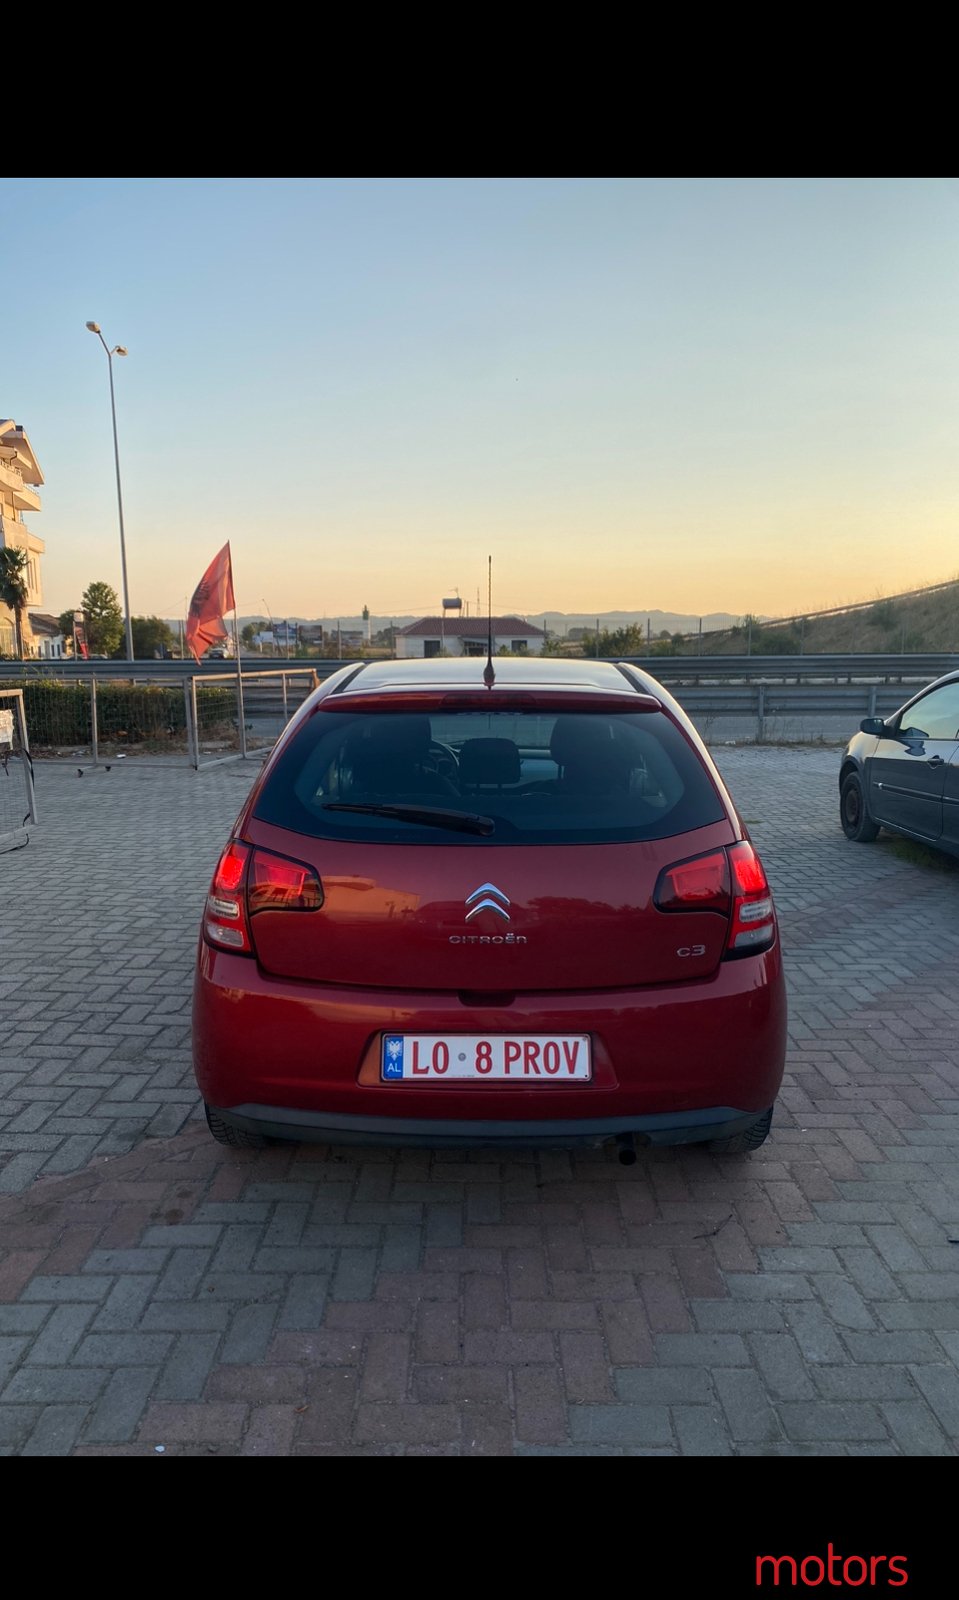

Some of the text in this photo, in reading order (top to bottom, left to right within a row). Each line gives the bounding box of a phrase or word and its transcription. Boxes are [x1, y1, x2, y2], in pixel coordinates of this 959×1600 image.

[387, 1062, 401, 1073] AL
[475, 1041, 493, 1075] 8
[504, 1041, 580, 1075] PROV
